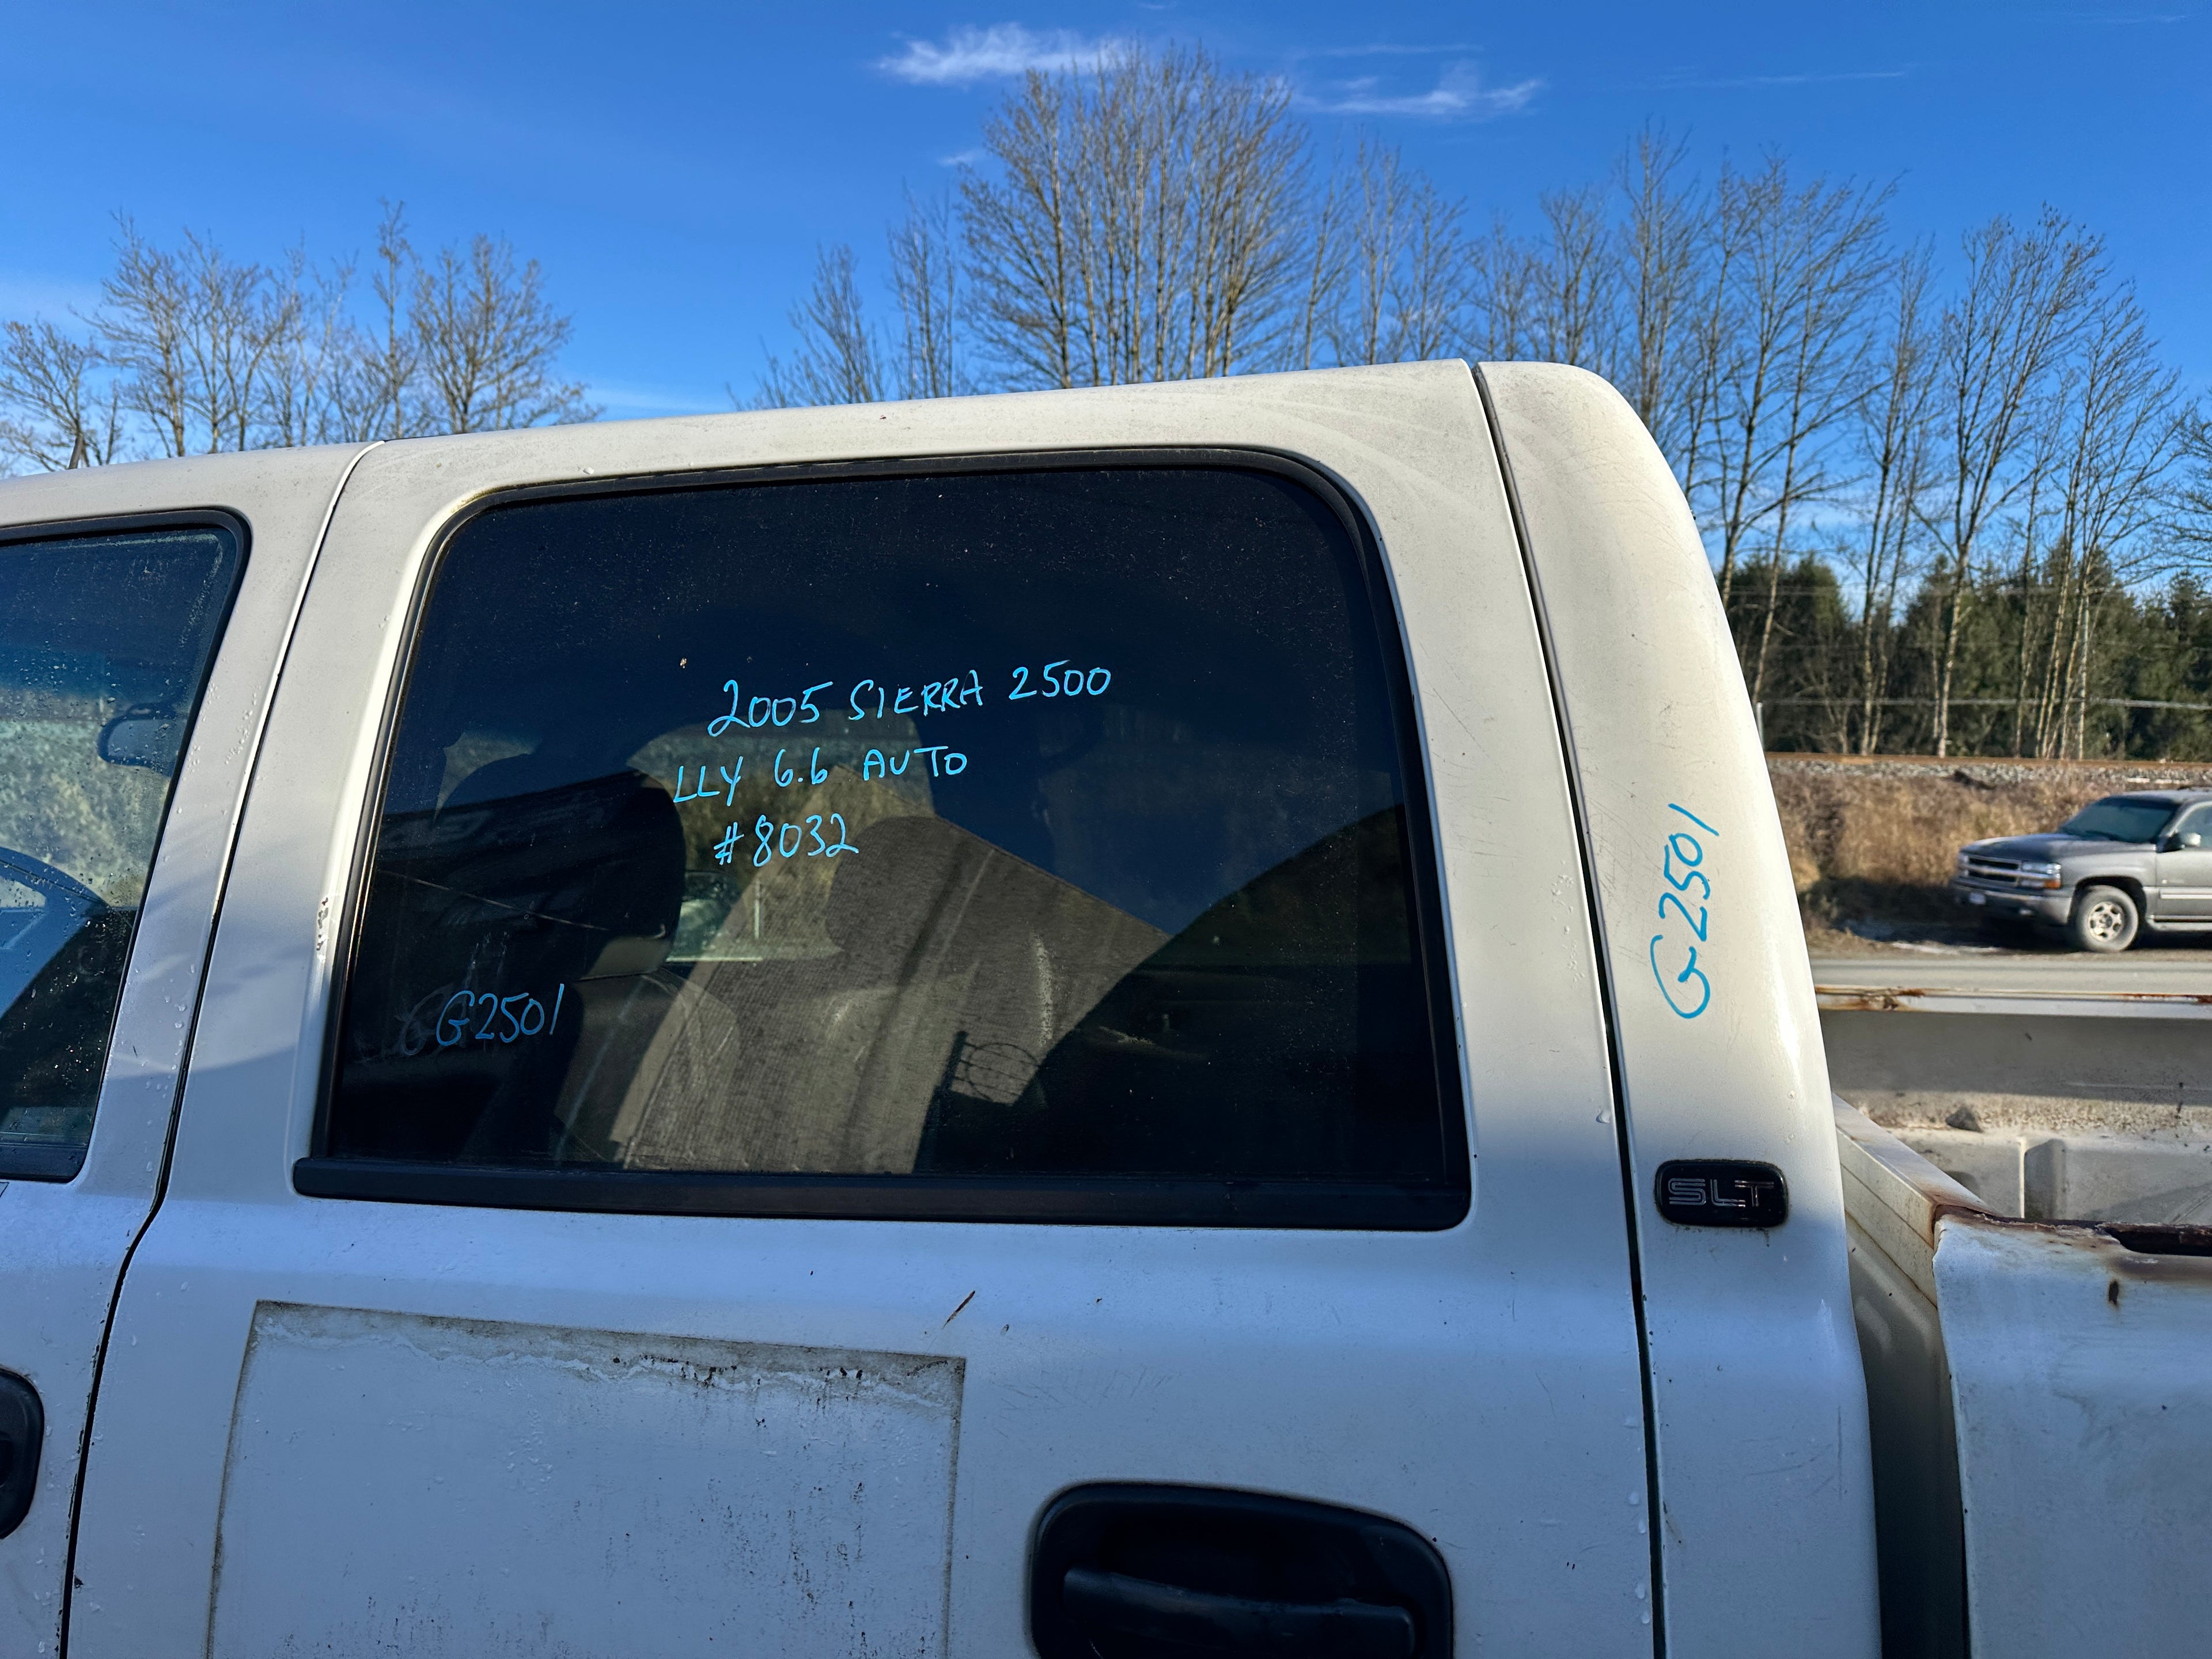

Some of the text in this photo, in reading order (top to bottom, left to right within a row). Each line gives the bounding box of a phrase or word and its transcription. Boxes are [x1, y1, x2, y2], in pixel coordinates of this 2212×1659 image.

[707, 660, 1111, 737] 2005 SIERRA 2500
[673, 745, 968, 806] LLY 6.6 AUTO
[713, 813, 859, 867] #8032
[1650, 803, 1719, 1019] G2501
[435, 983, 565, 1046] G2501
[1668, 1178, 1775, 1207] SLT
